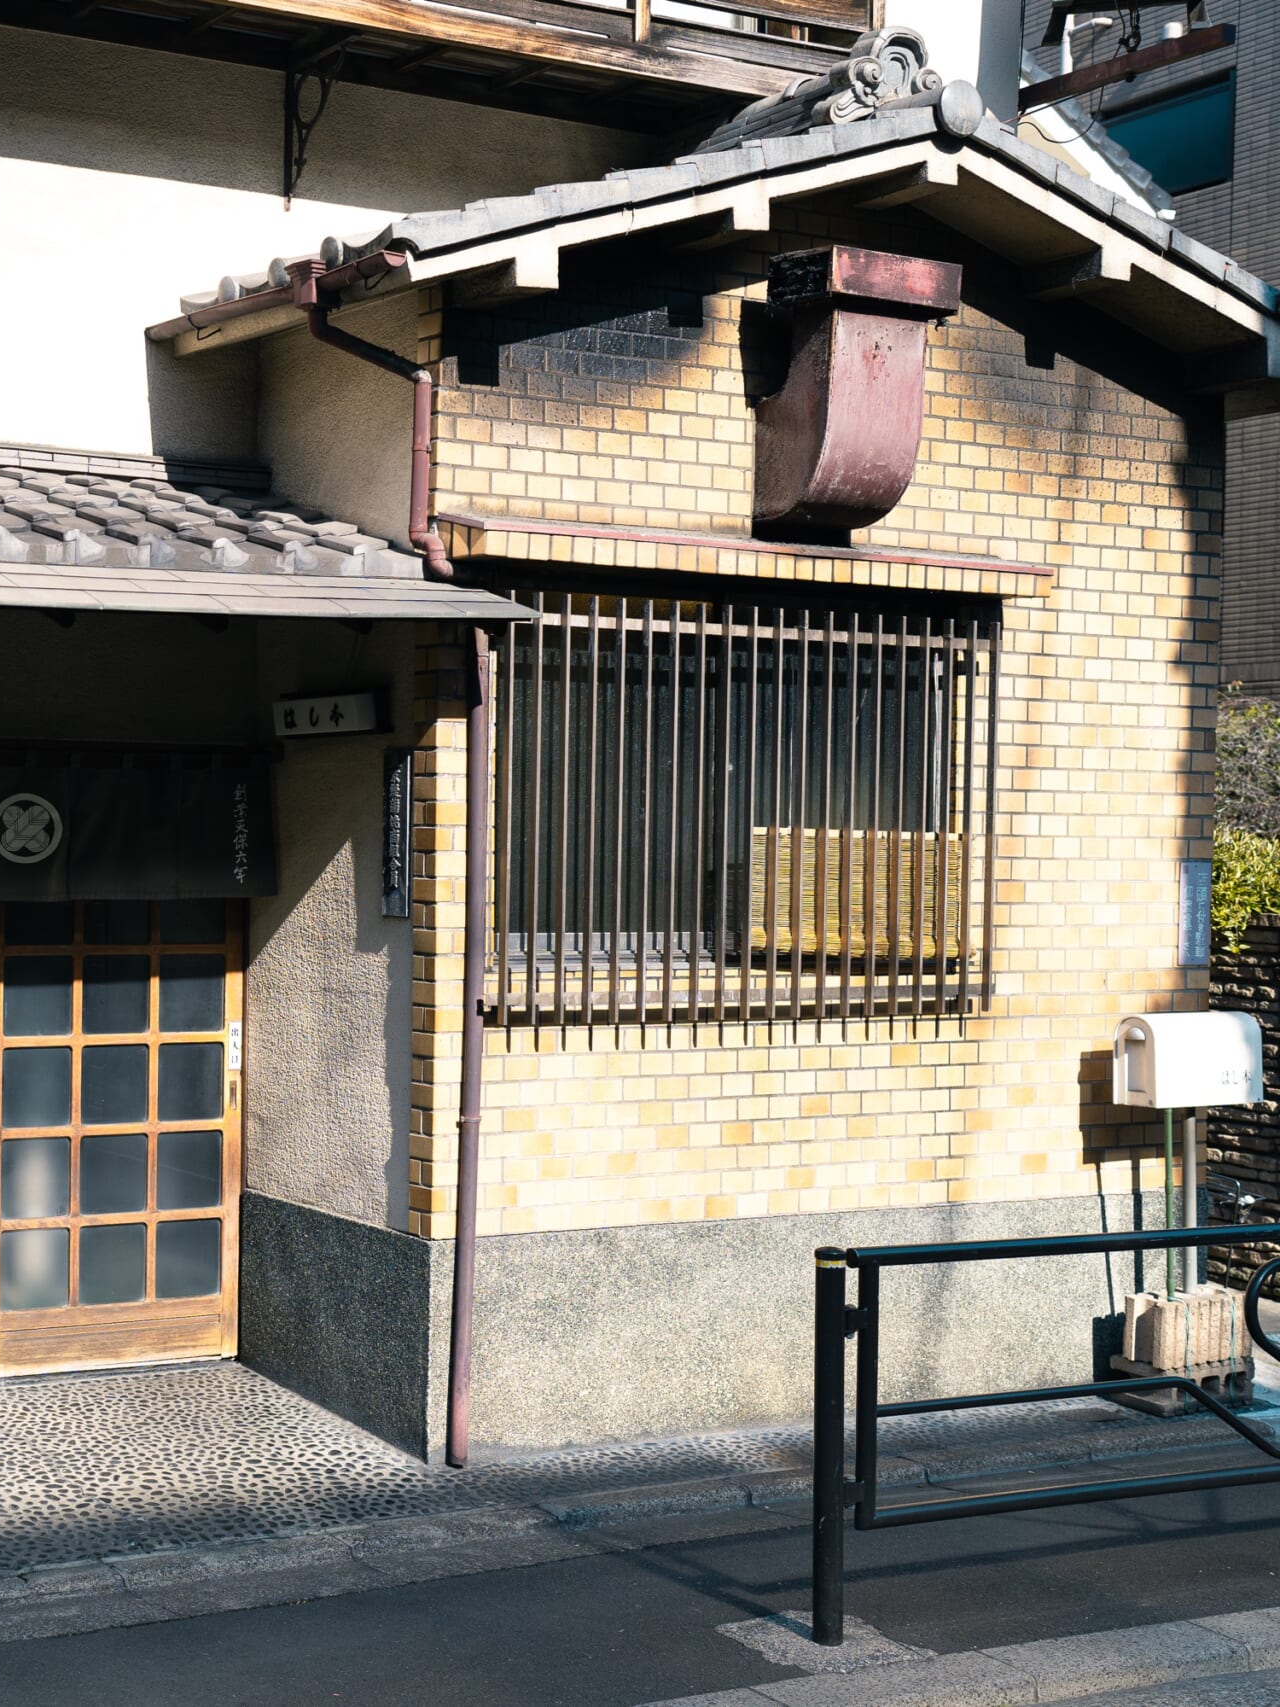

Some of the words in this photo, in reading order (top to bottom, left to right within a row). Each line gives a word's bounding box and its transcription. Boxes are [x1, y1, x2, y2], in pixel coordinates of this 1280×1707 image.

[284, 703, 344, 729] はし本
[231, 1028, 239, 1064] 出入口
[1221, 1069, 1251, 1085] はし本
